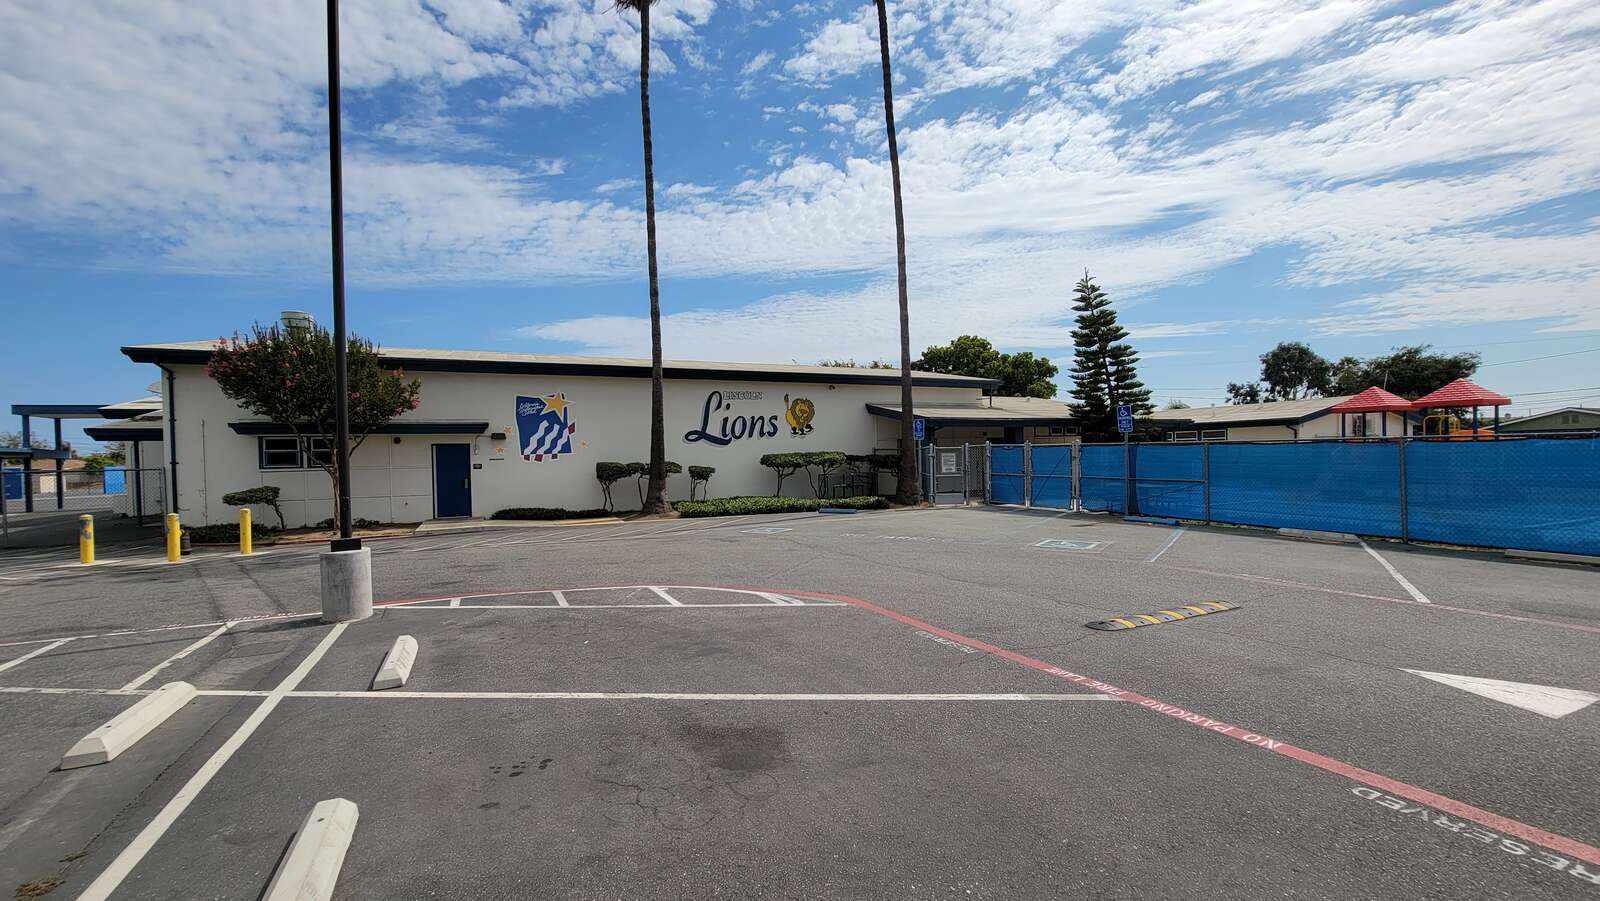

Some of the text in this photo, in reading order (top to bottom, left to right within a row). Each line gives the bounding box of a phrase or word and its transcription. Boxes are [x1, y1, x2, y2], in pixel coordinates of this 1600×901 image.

[722, 391, 762, 400] LINCOLN
[684, 390, 779, 446] Lions
[1083, 680, 1129, 696] FIRE
[1139, 699, 1235, 734] PARKING
[1242, 733, 1283, 750] NO
[1349, 786, 1600, 885] RESERVED
